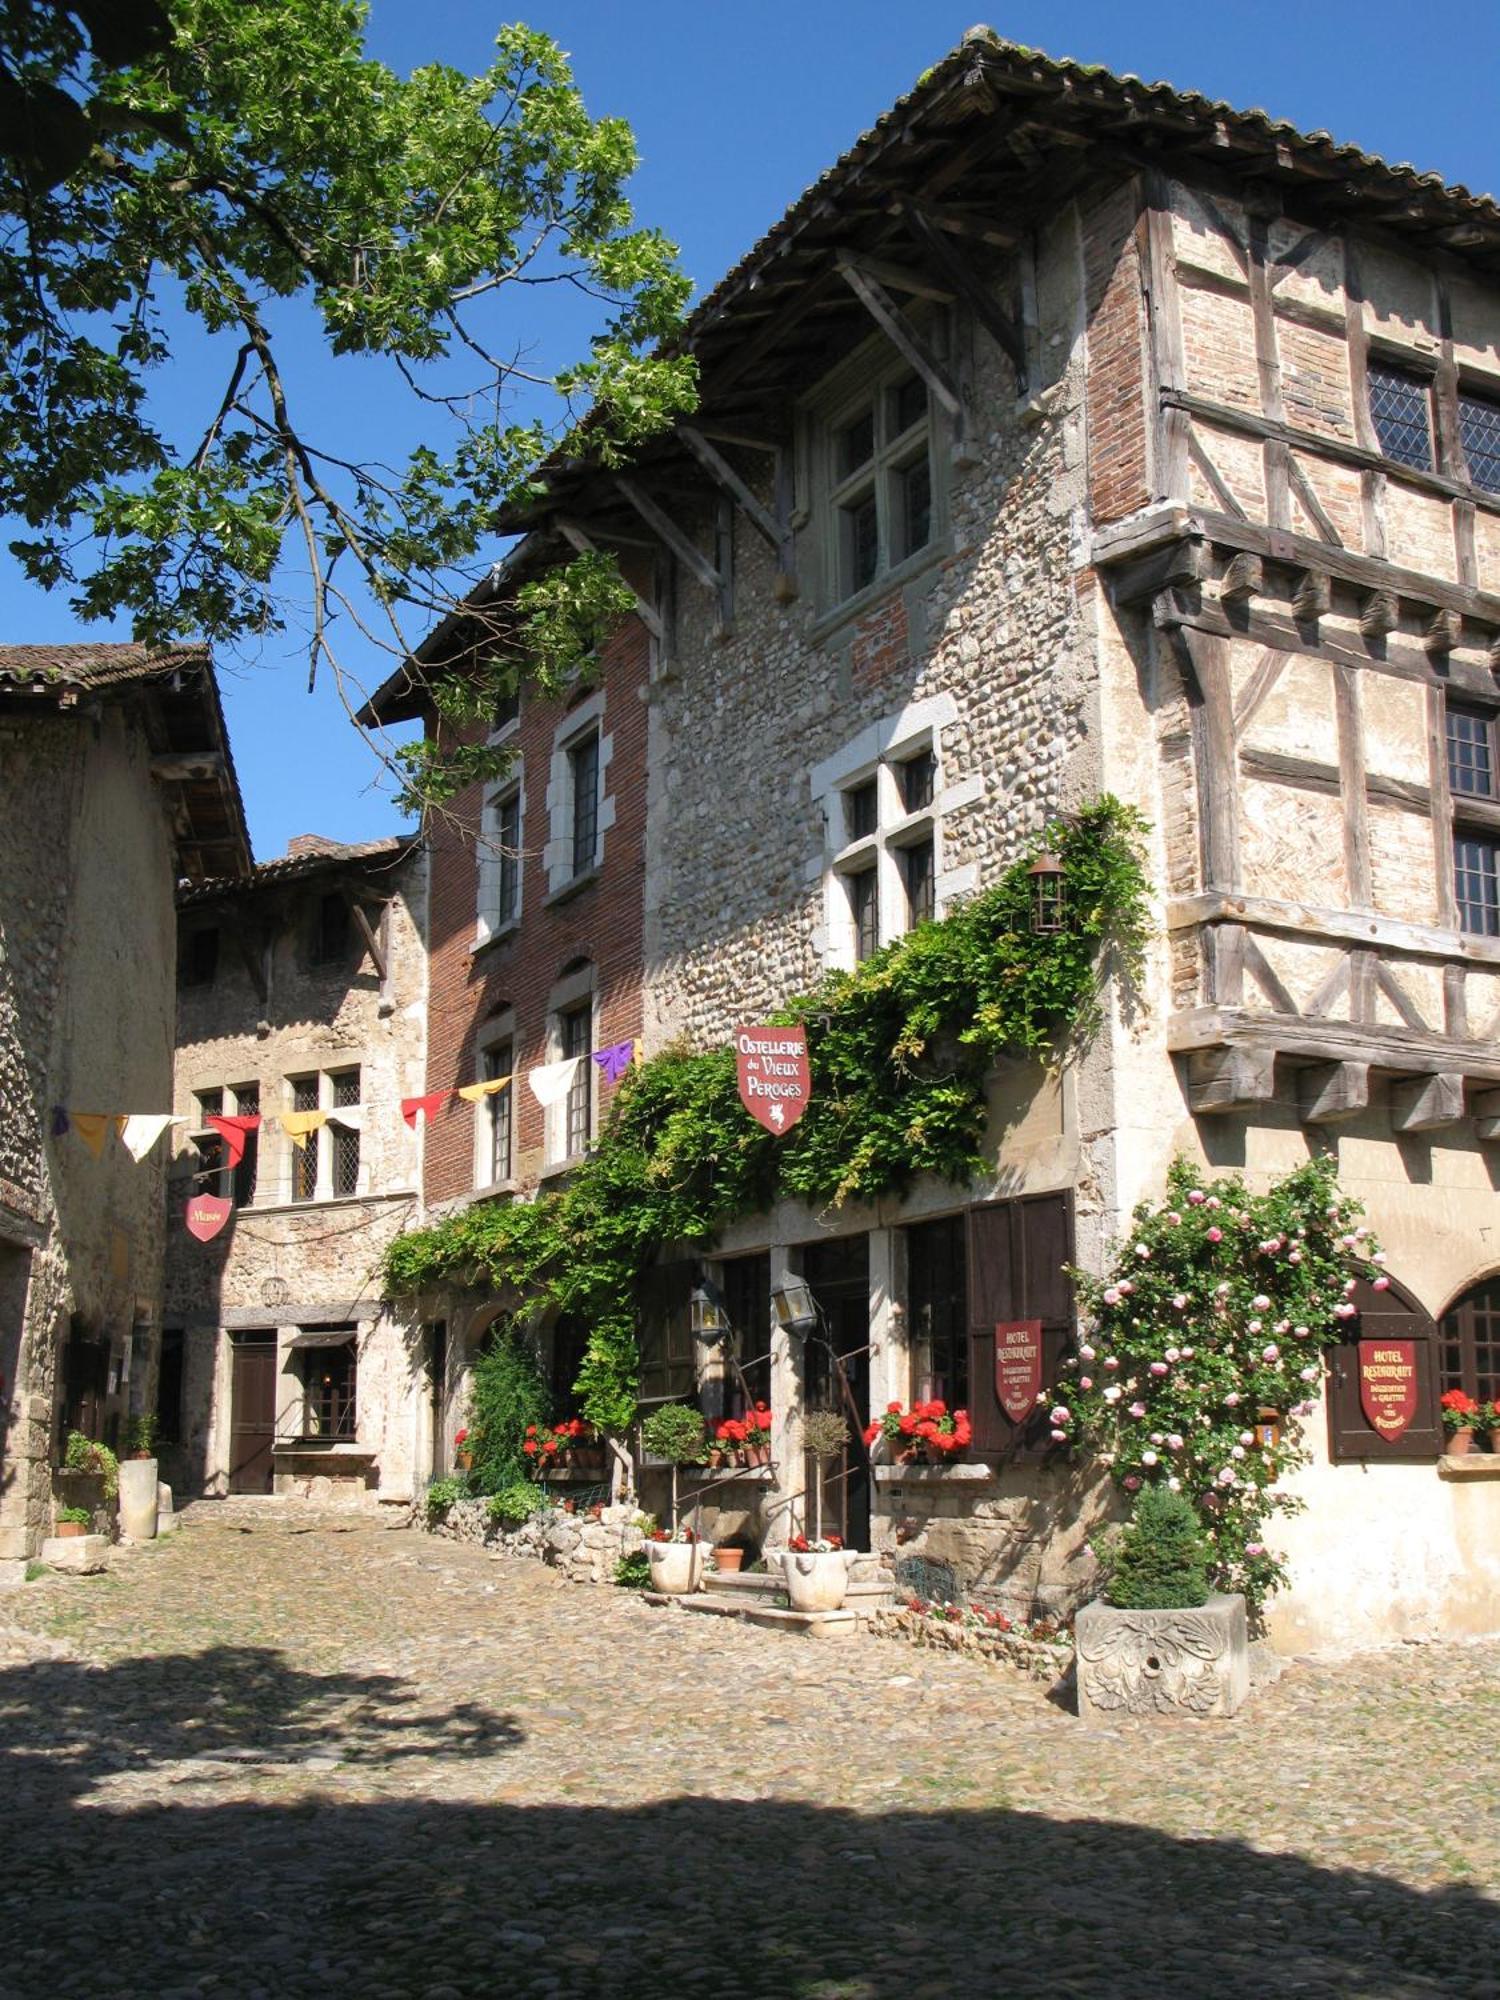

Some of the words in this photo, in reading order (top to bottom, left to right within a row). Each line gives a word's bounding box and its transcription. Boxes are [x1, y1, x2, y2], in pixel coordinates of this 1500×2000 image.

[761, 1056, 800, 1076] VIEUX
[1373, 1350, 1403, 1363] HOTEL
[1363, 1365, 1413, 1381] RESTAURANT
